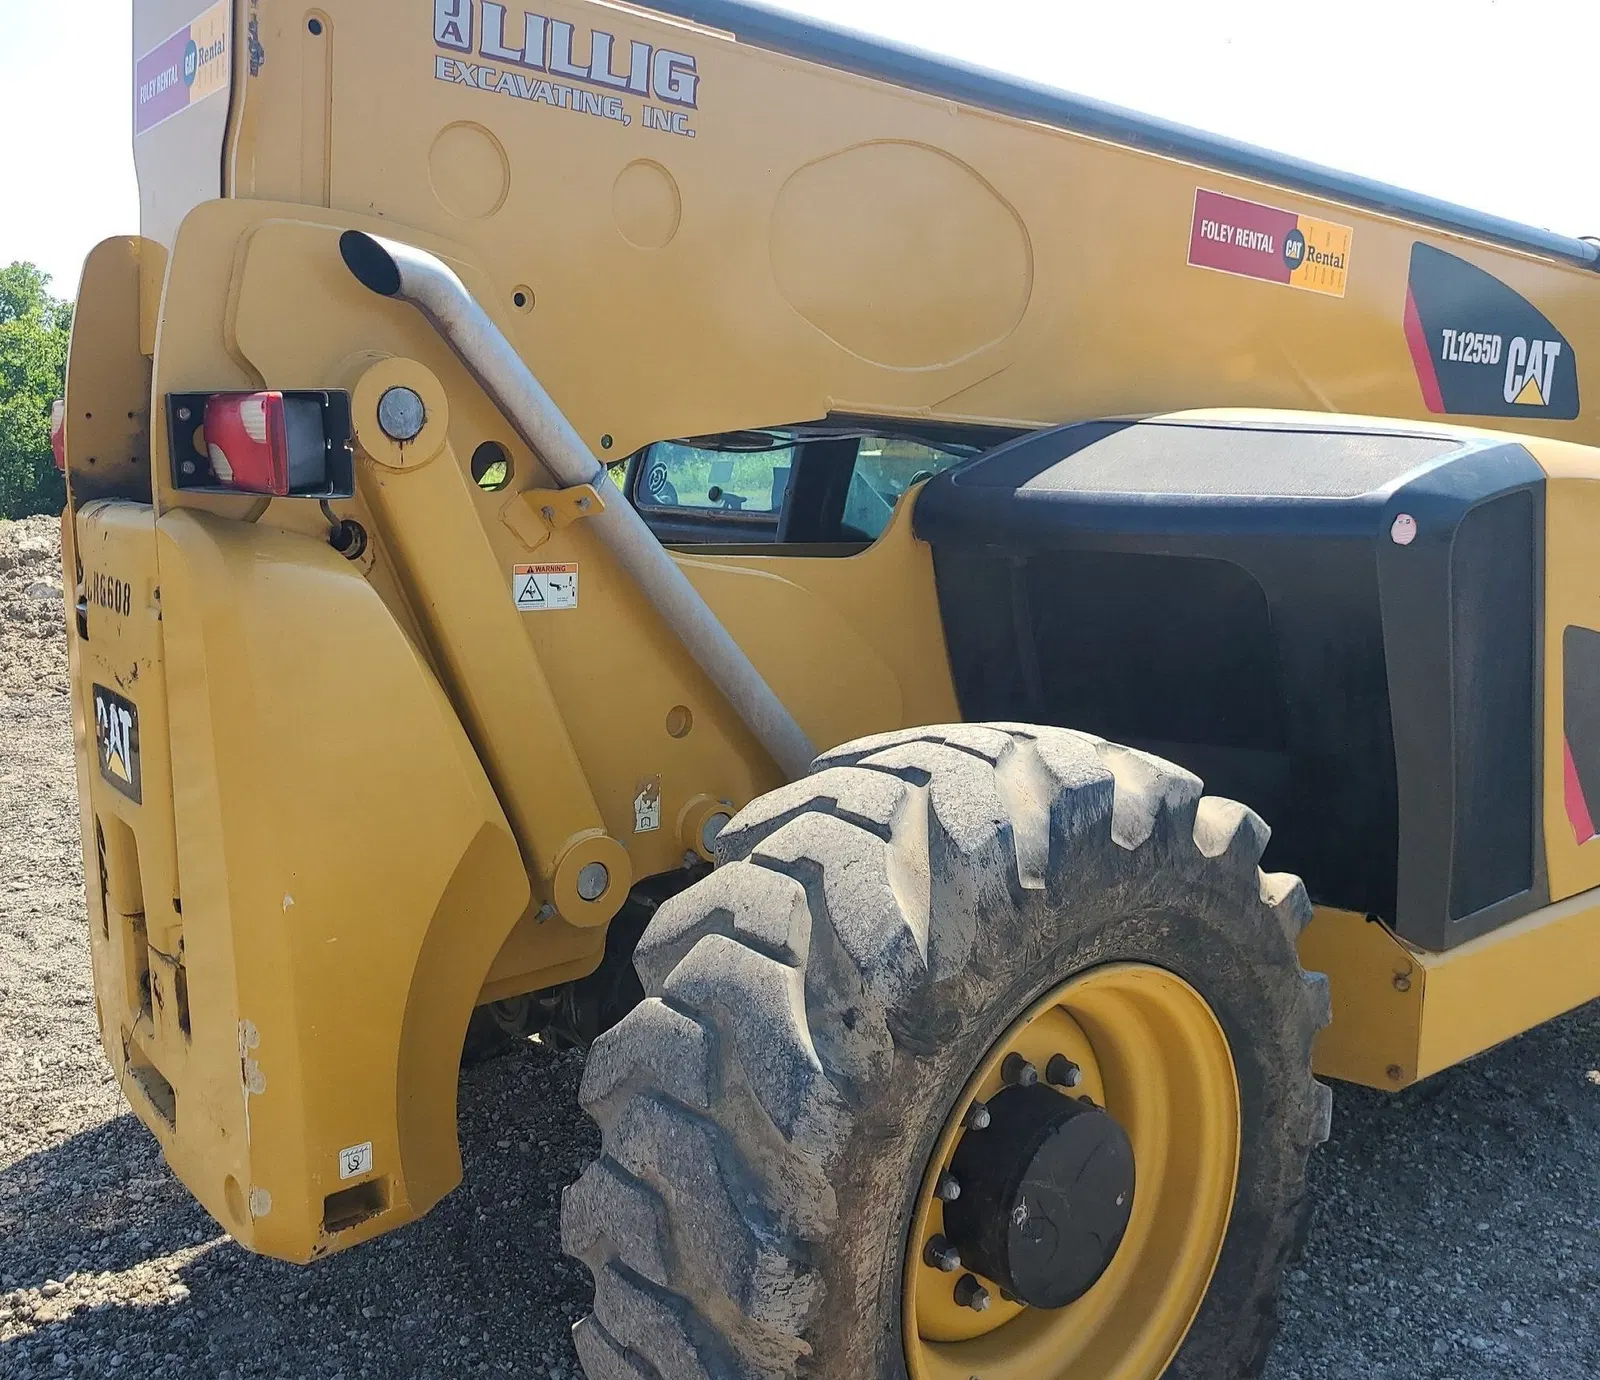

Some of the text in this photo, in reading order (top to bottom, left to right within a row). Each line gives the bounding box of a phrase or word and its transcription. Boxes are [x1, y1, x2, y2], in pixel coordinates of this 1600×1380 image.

[184, 52, 195, 76] CAT
[198, 33, 225, 67] Rental
[479, 1, 700, 110] LILLIG
[140, 79, 157, 104] FOLEY
[156, 64, 178, 93] RENTAL
[435, 55, 696, 138] EXCAVATING, INC.
[1200, 219, 1275, 254] FOLEY RENTAL
[1285, 239, 1345, 270] CAT Rental
[1441, 329, 1562, 406] TL1255D CAT
[535, 565, 566, 573] WARNING
